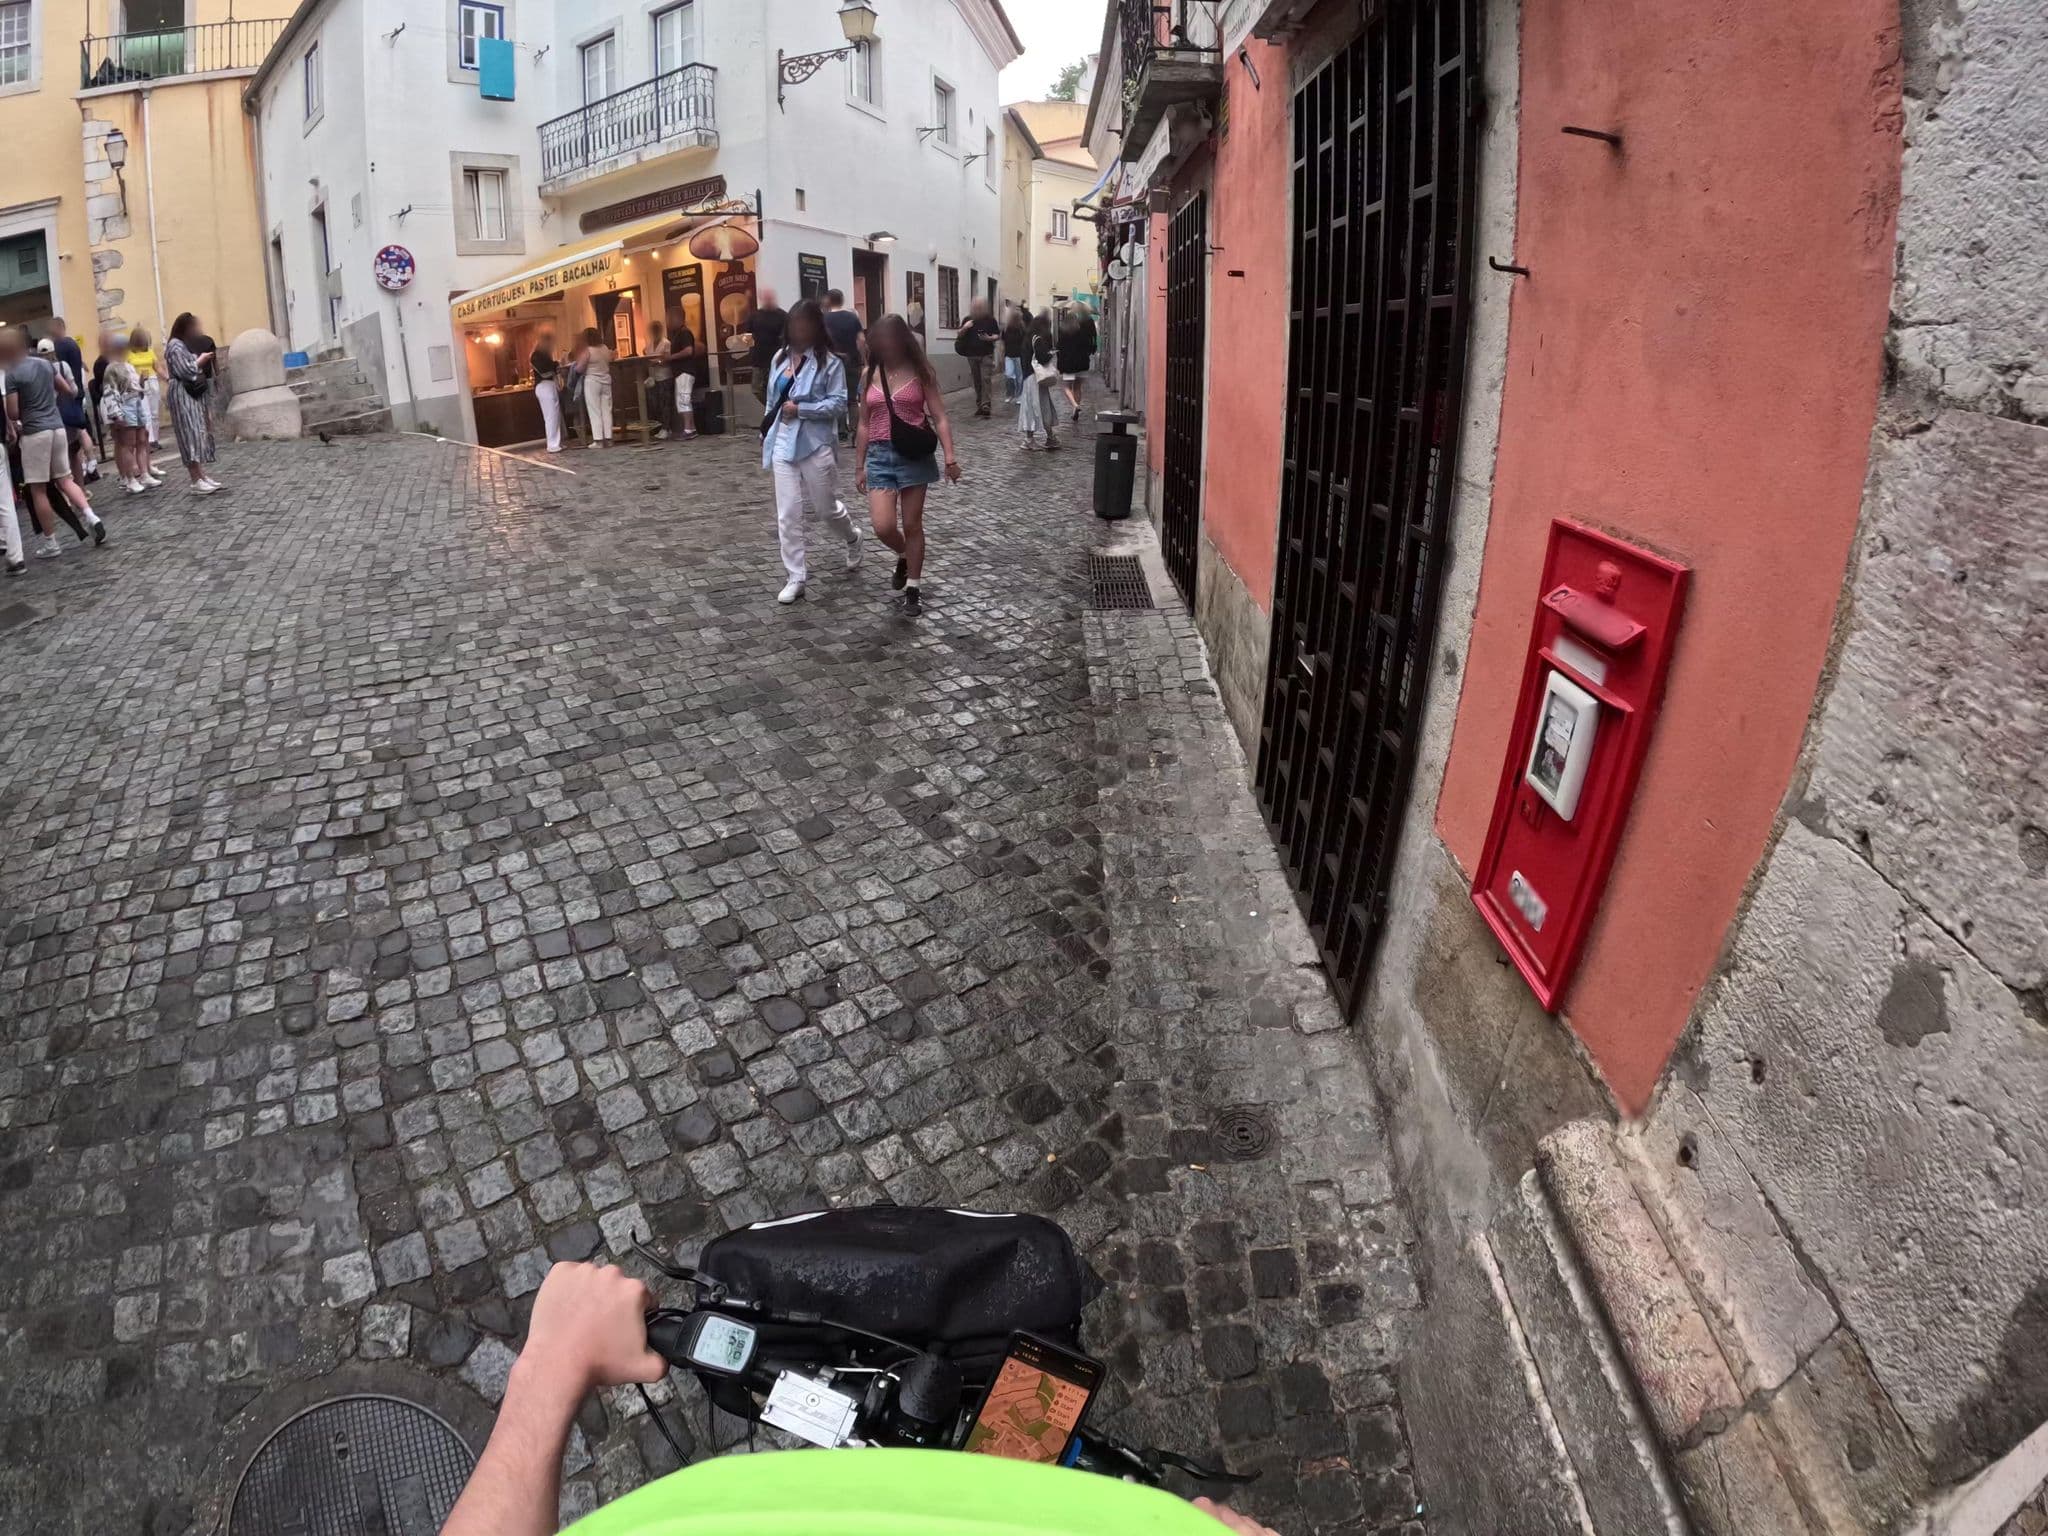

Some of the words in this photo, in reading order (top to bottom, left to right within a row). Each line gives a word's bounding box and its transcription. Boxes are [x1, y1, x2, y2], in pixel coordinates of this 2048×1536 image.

[647, 195, 671, 209] PASTEL
[684, 182, 720, 200] BACALHAU
[457, 304, 475, 319] CASA
[529, 274, 558, 294] PASTEL
[562, 257, 611, 284] BACALHAU
